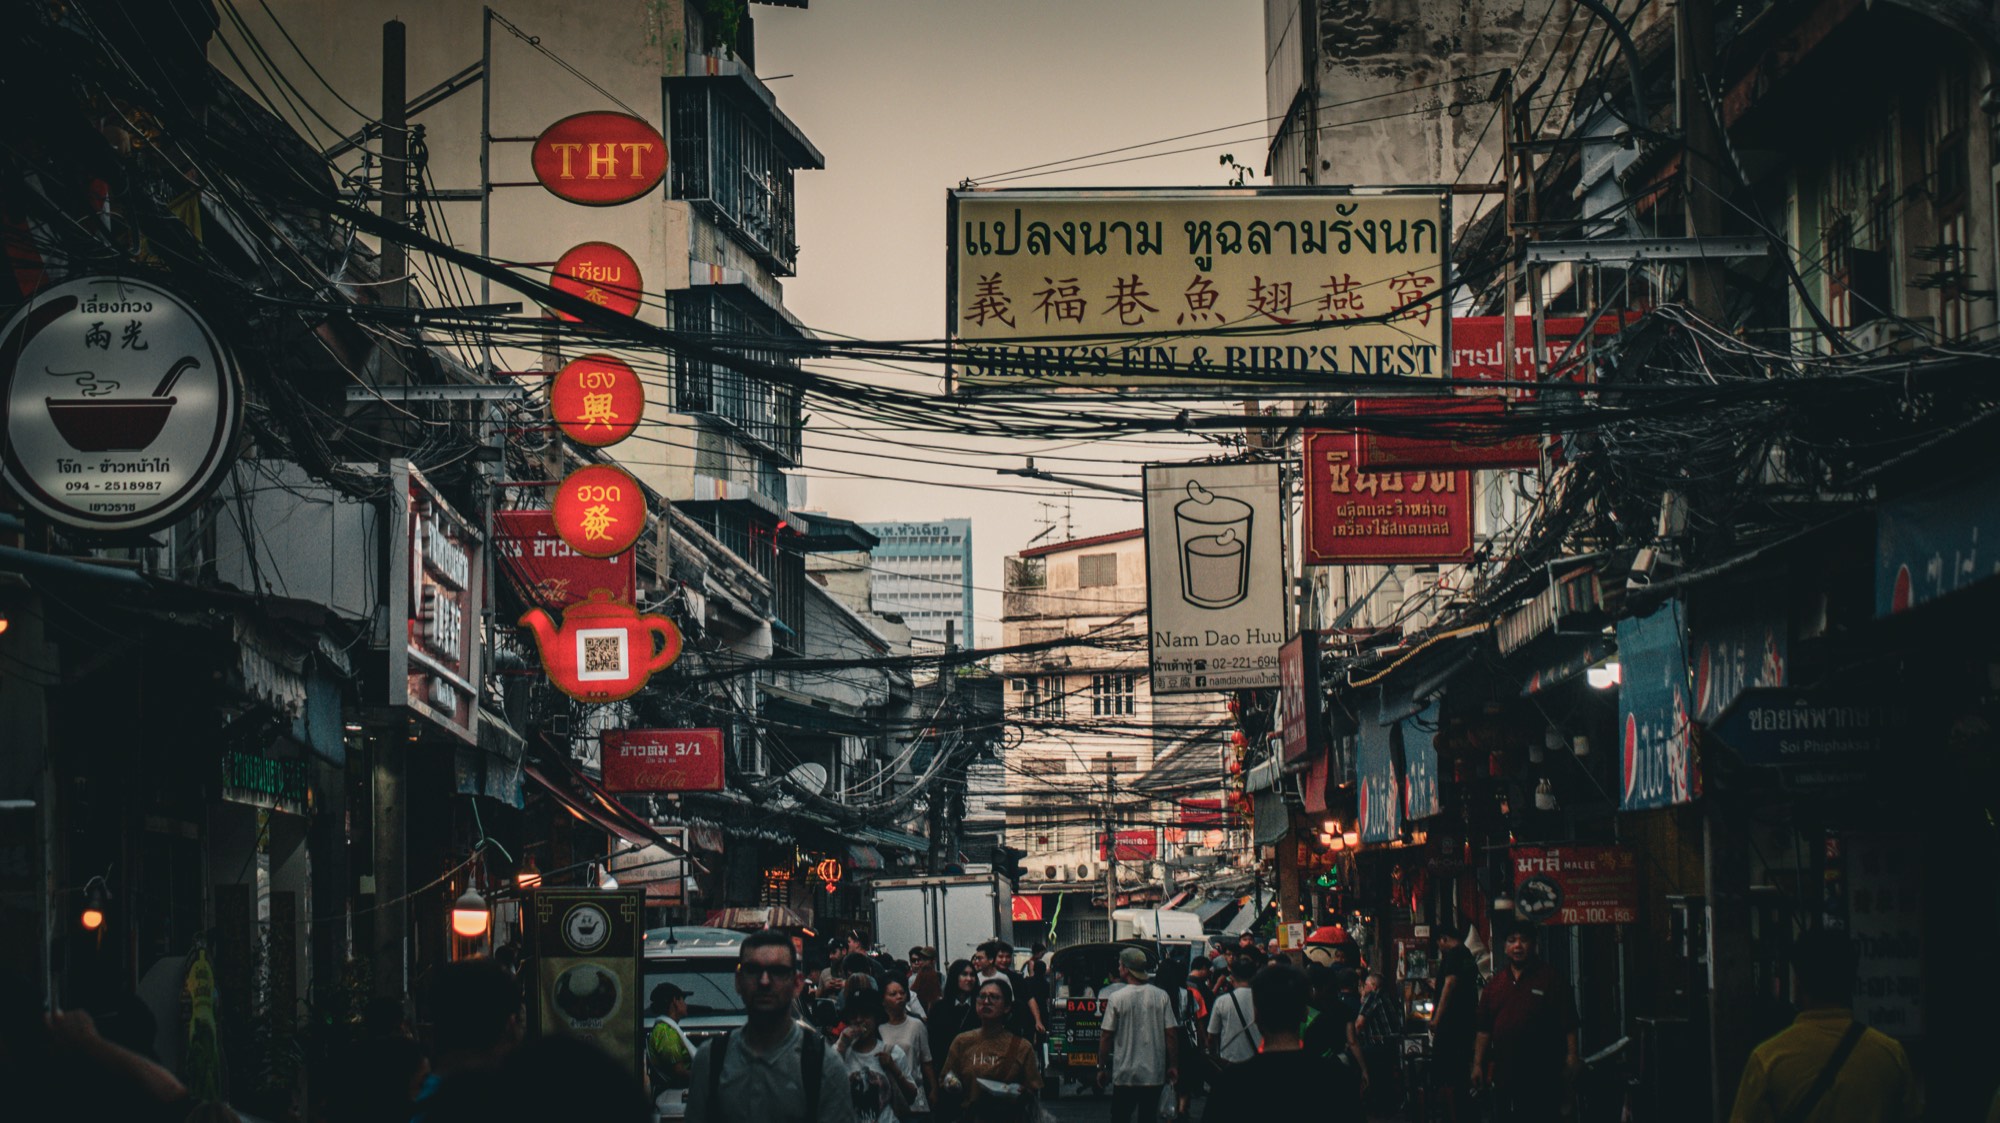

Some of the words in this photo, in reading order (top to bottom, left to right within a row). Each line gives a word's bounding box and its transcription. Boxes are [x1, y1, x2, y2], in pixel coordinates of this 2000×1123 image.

[551, 143, 653, 180] THT
[965, 208, 1163, 257] แปลงนาม
[1182, 203, 1438, 273] หูฉลามรังนก
[81, 294, 154, 314] เลี่ยงกวง
[963, 271, 1437, 330] 義福巷魚翅燕窩
[965, 346, 1109, 377] SHARK'S
[1191, 346, 1217, 376] &
[1224, 346, 1340, 377] BIRD'S
[1349, 346, 1437, 377] NEST
[579, 372, 616, 389] เฮง
[577, 392, 619, 432] 興
[57, 459, 82, 474] โจ๊ก
[100, 458, 171, 474] ข้าวหน้าไก่
[66, 481, 90, 491] 094
[105, 481, 162, 491] 2518987
[577, 485, 622, 502] ฮวด
[89, 502, 136, 513] เยาวราช
[580, 504, 619, 541] 發
[1155, 631, 1199, 648] Nam
[1205, 629, 1240, 646] Dao
[1246, 627, 1282, 645] Huu
[620, 740, 669, 757] ข้าวต้ม
[675, 741, 702, 756] 3/1
[1780, 740, 1800, 754] Soi
[1517, 849, 1561, 872] มาลี
[1564, 861, 1597, 871] MALEE
